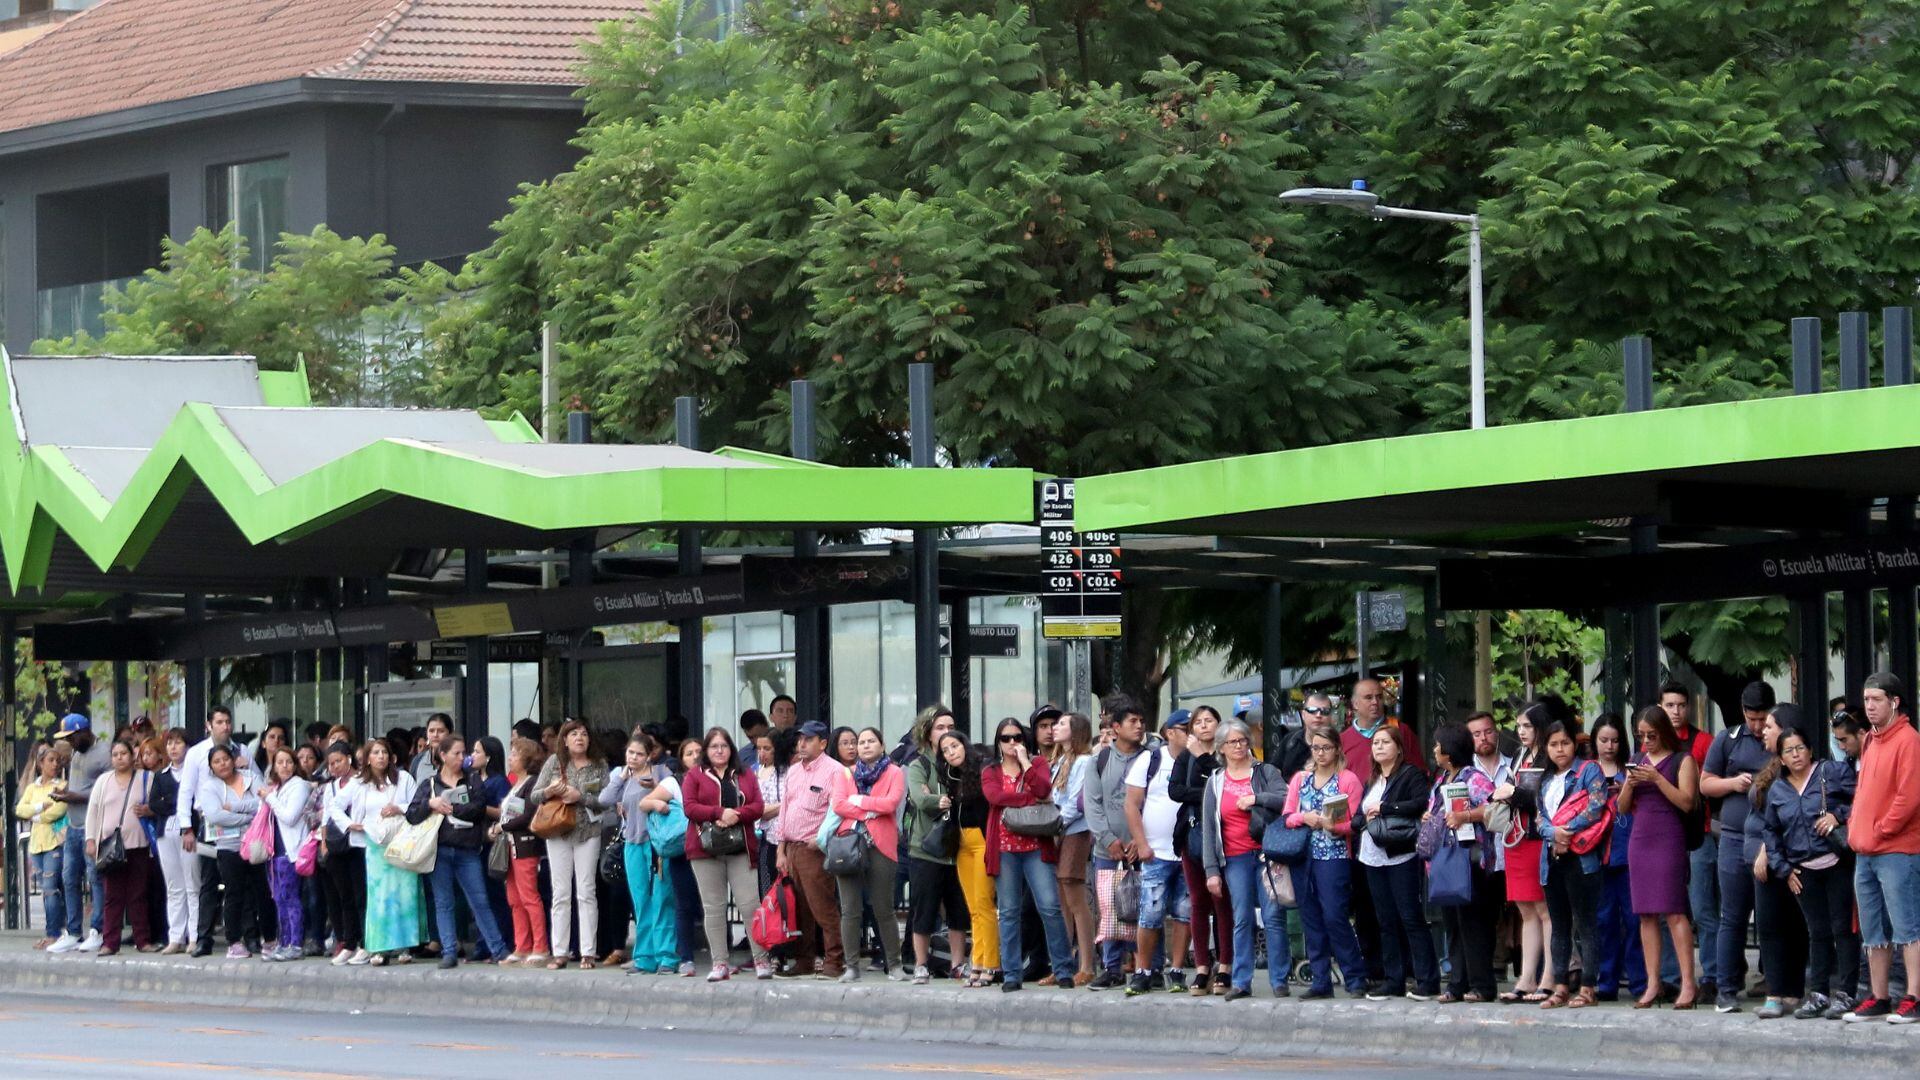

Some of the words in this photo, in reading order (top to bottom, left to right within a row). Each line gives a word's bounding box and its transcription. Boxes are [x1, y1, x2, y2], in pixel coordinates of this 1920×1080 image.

[1049, 531, 1073, 541] 406
[1086, 532, 1116, 541] 406c
[1050, 554, 1074, 565] 426
[1089, 554, 1113, 564] 430
[1779, 556, 1825, 575] Escuela
[1825, 553, 1866, 573] Militar
[1877, 547, 1920, 568] Parada
[1050, 577, 1074, 588] C01
[1087, 577, 1117, 587] C01c
[604, 594, 634, 610] Escuela
[633, 592, 660, 608] Militar
[665, 589, 693, 605] Parada
[252, 626, 277, 640] Escuela
[275, 623, 298, 637] Militar
[302, 621, 326, 636] Parada
[997, 627, 1016, 636] LILLO
